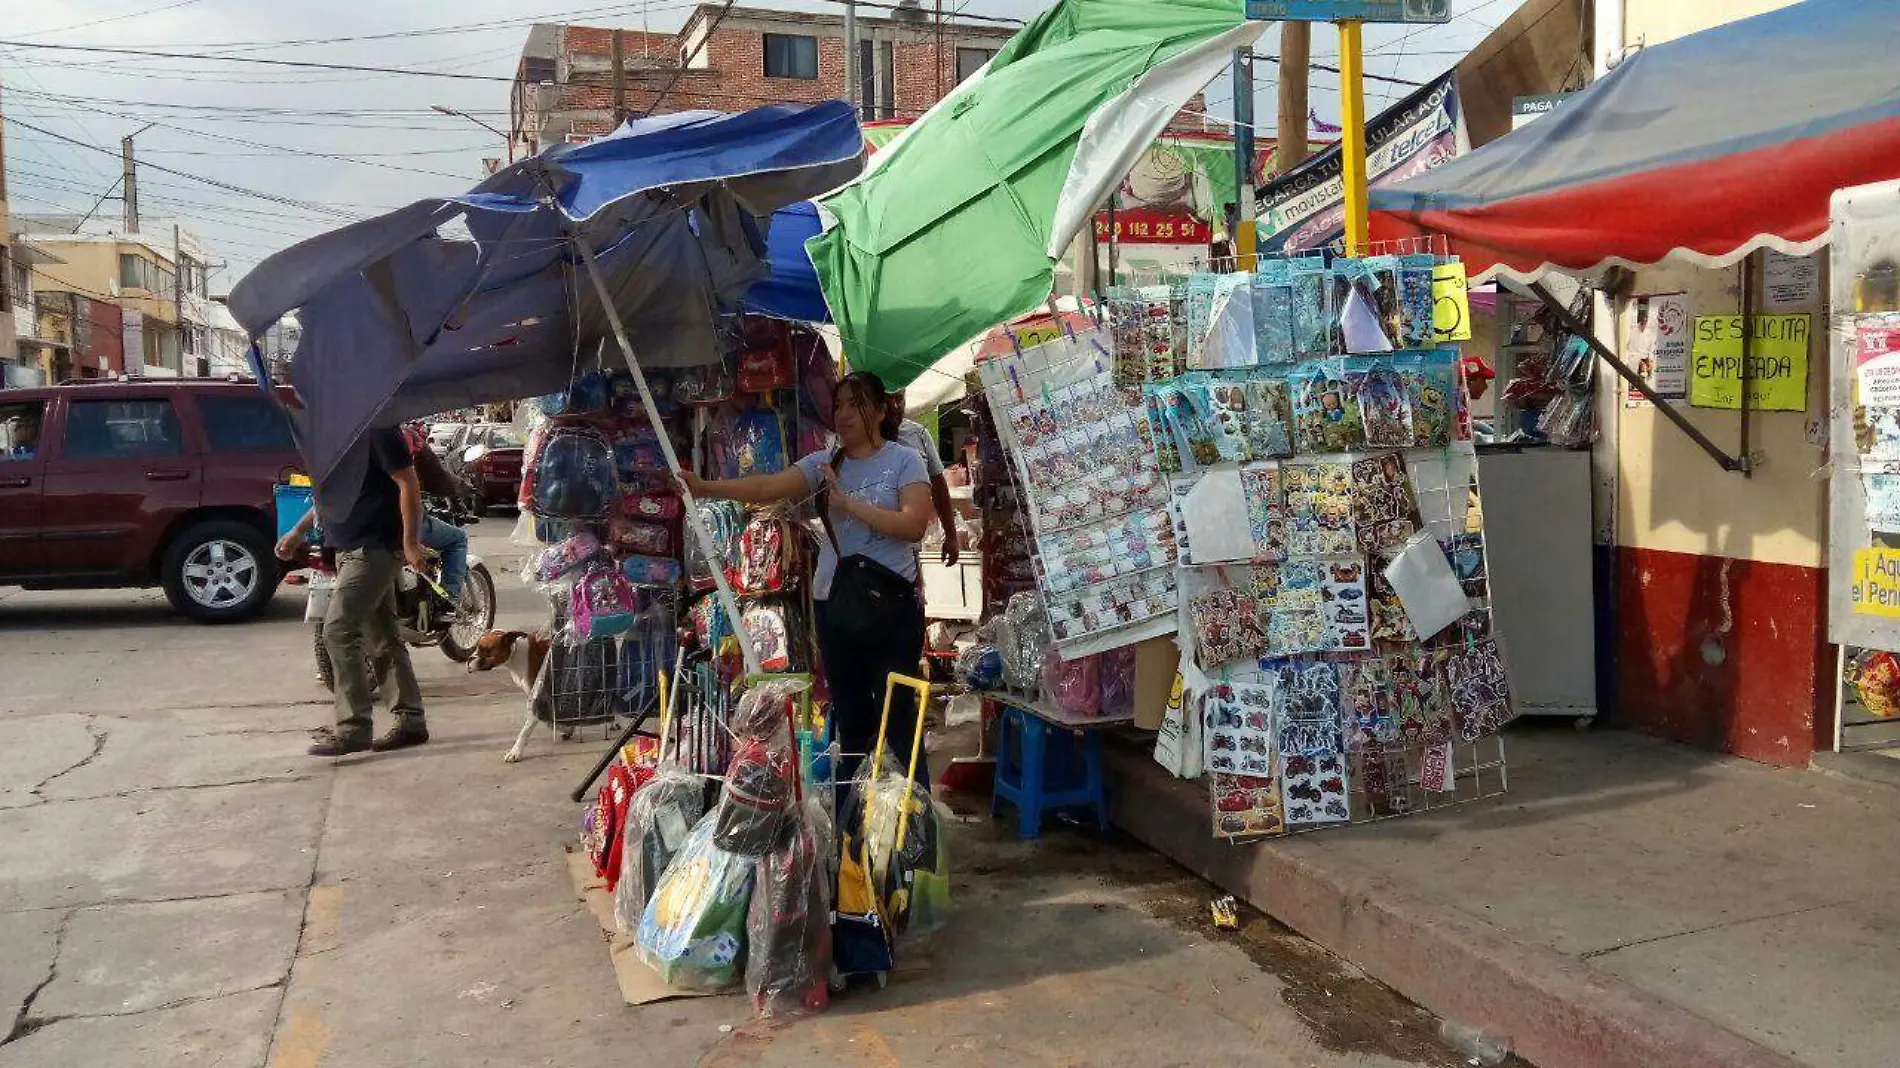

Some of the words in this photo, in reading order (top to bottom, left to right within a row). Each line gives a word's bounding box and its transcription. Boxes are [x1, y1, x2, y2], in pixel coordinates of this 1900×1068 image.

[1523, 100, 1554, 112] PAGA
[1390, 110, 1447, 163] telcel
[1255, 172, 1321, 212] ECARGA
[1319, 157, 1341, 178] TU
[1285, 178, 1344, 220] movistar
[1156, 223, 1173, 237] 25
[1699, 318, 1724, 342] SE
[1730, 317, 1806, 343] SLICITA
[1696, 355, 1791, 381] EMPLEADA
[1852, 579, 1864, 602] el
